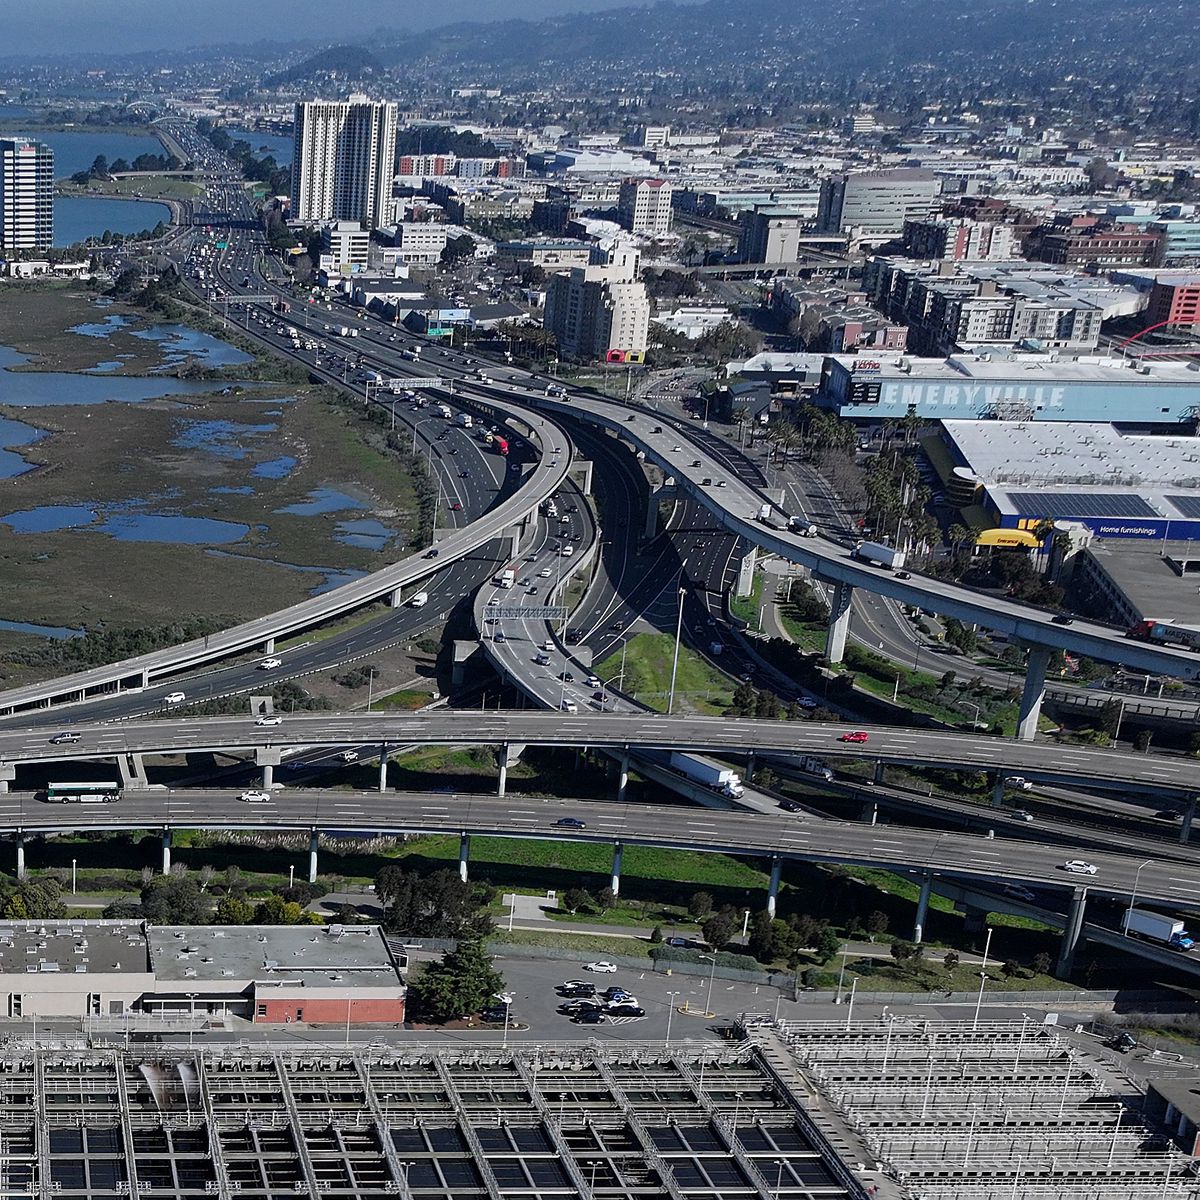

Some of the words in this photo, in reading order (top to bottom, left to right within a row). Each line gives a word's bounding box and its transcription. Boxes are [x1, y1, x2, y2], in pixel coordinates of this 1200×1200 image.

[885, 382, 1065, 407] EMERYVILLE
[1100, 526, 1120, 534] Home
[1120, 526, 1156, 536] furnishings
